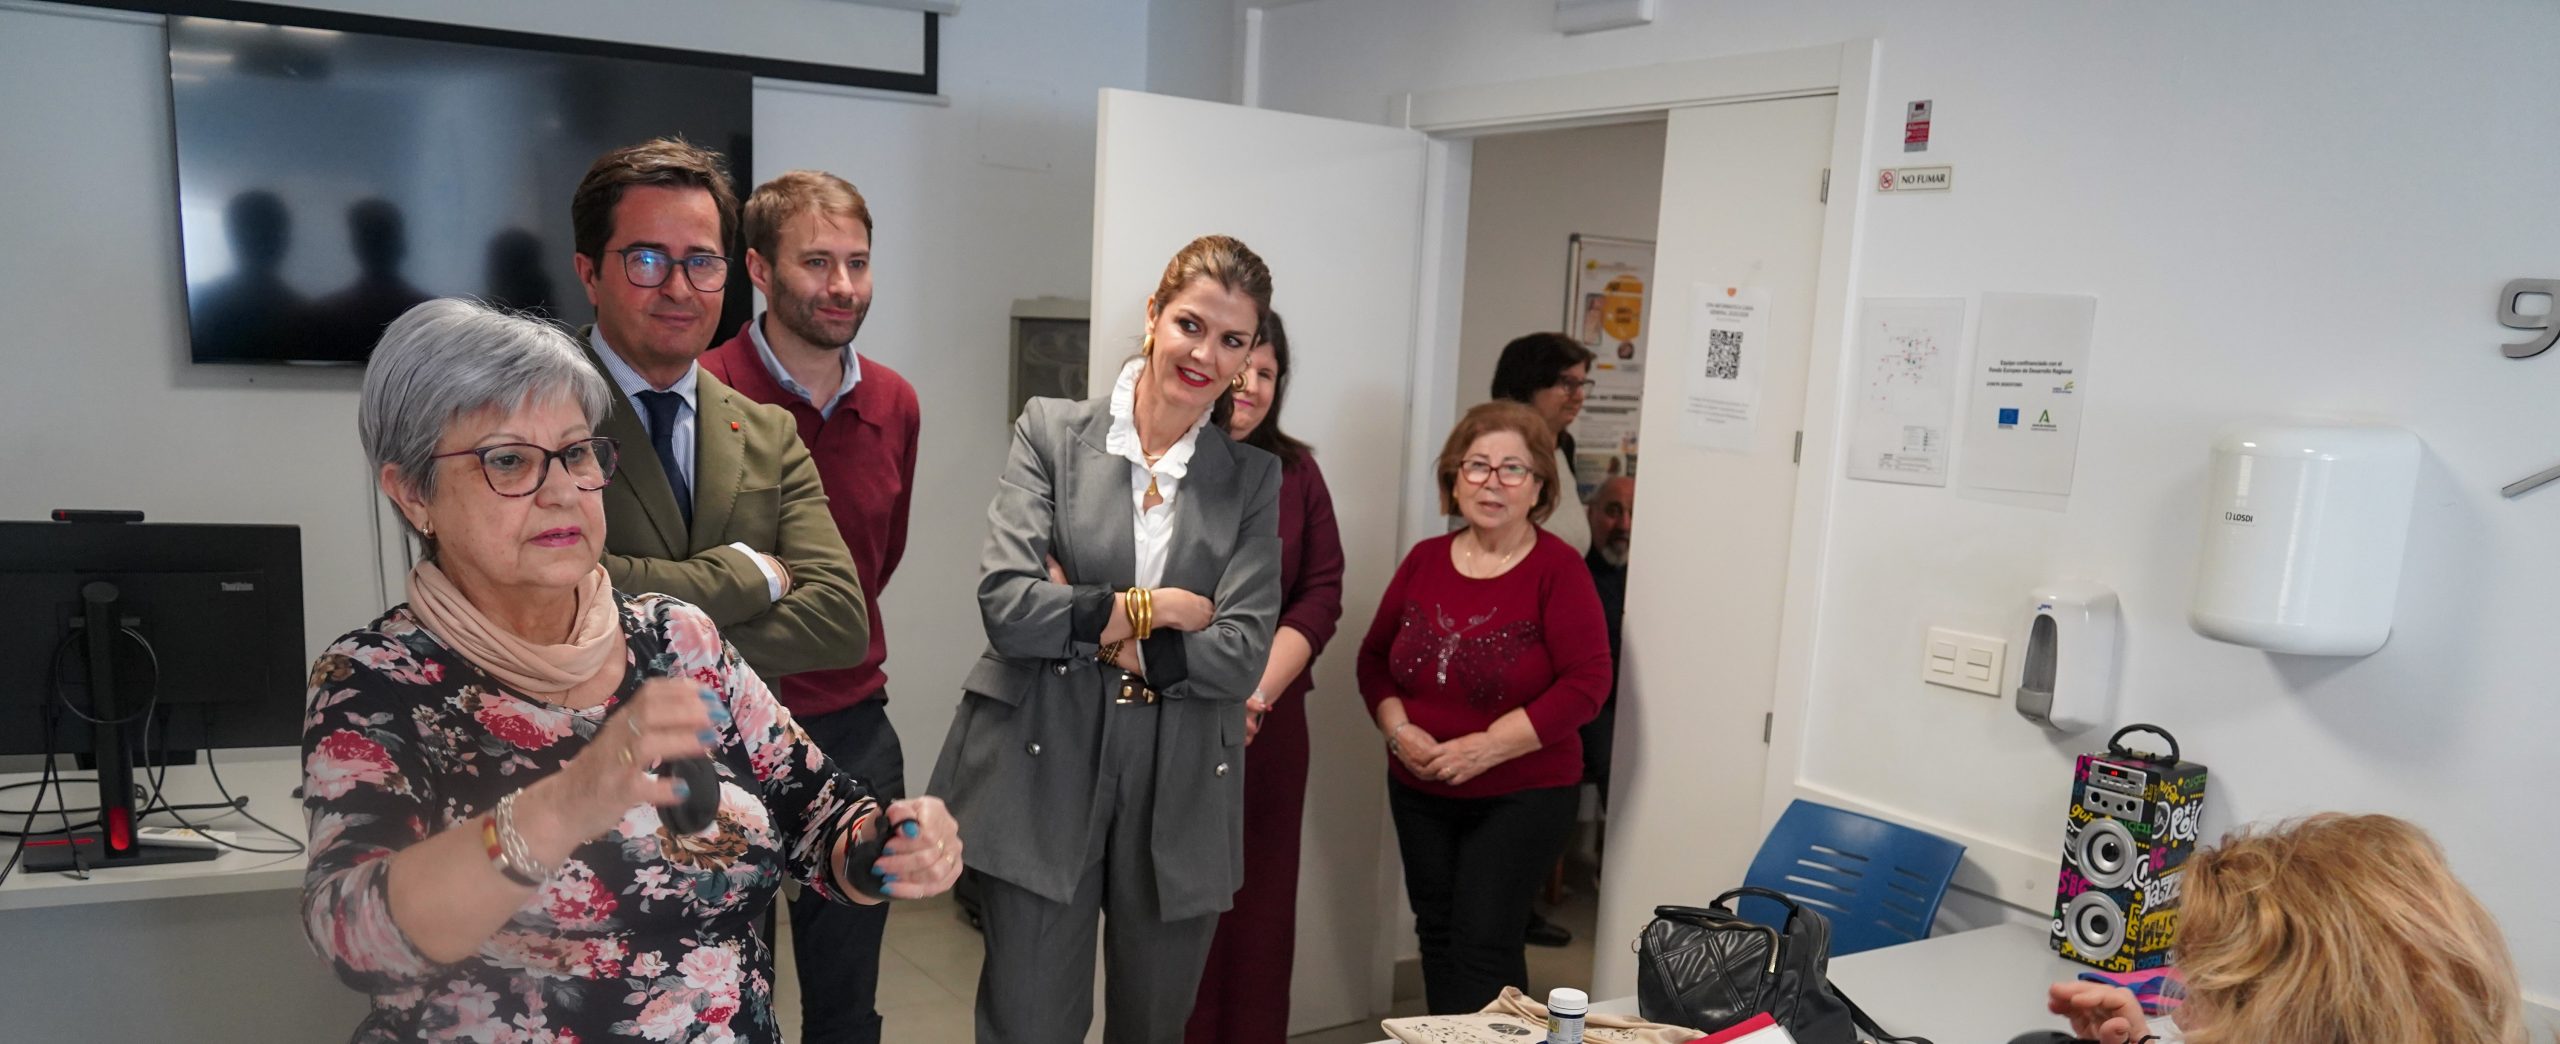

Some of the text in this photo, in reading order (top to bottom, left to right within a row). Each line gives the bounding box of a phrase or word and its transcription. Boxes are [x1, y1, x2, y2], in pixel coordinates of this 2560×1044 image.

[1902, 174, 1946, 184] NO FUMAR
[2499, 278, 2560, 359] 9
[2233, 513, 2254, 523] LOSDI
